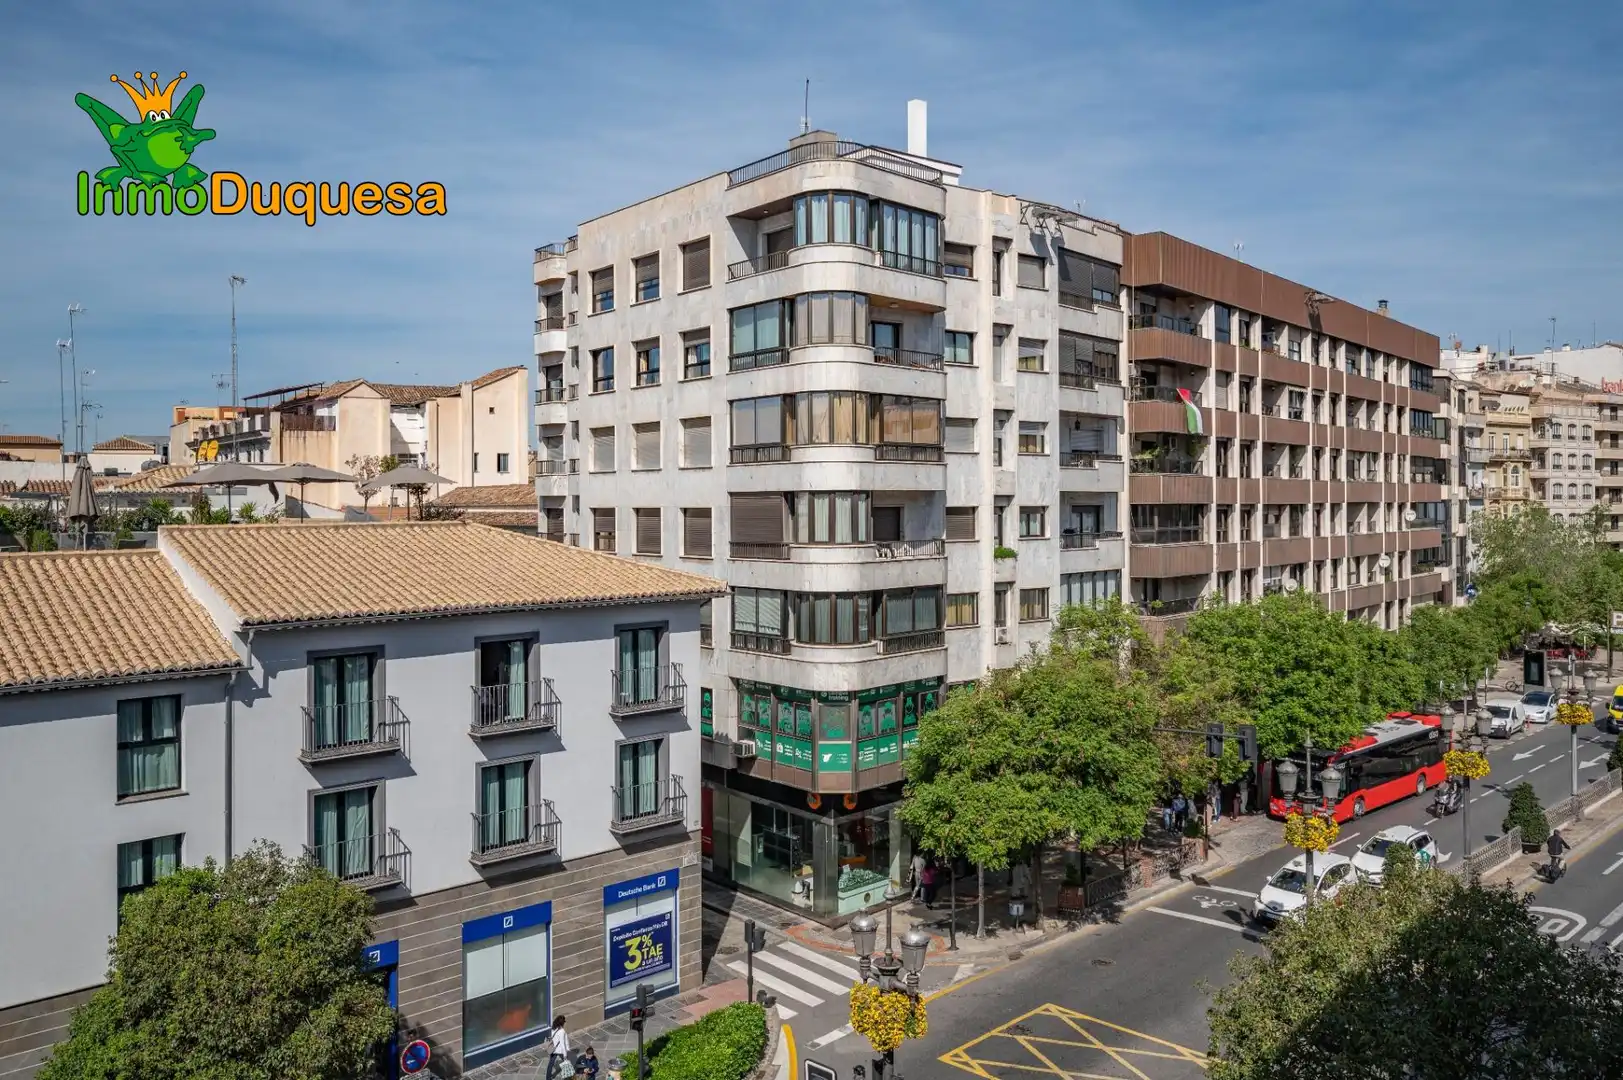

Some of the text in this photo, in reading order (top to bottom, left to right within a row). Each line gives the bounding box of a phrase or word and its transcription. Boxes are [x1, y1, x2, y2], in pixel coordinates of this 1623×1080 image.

[618, 884, 656, 898] Deutsche Bank
[642, 944, 664, 960] TAE
